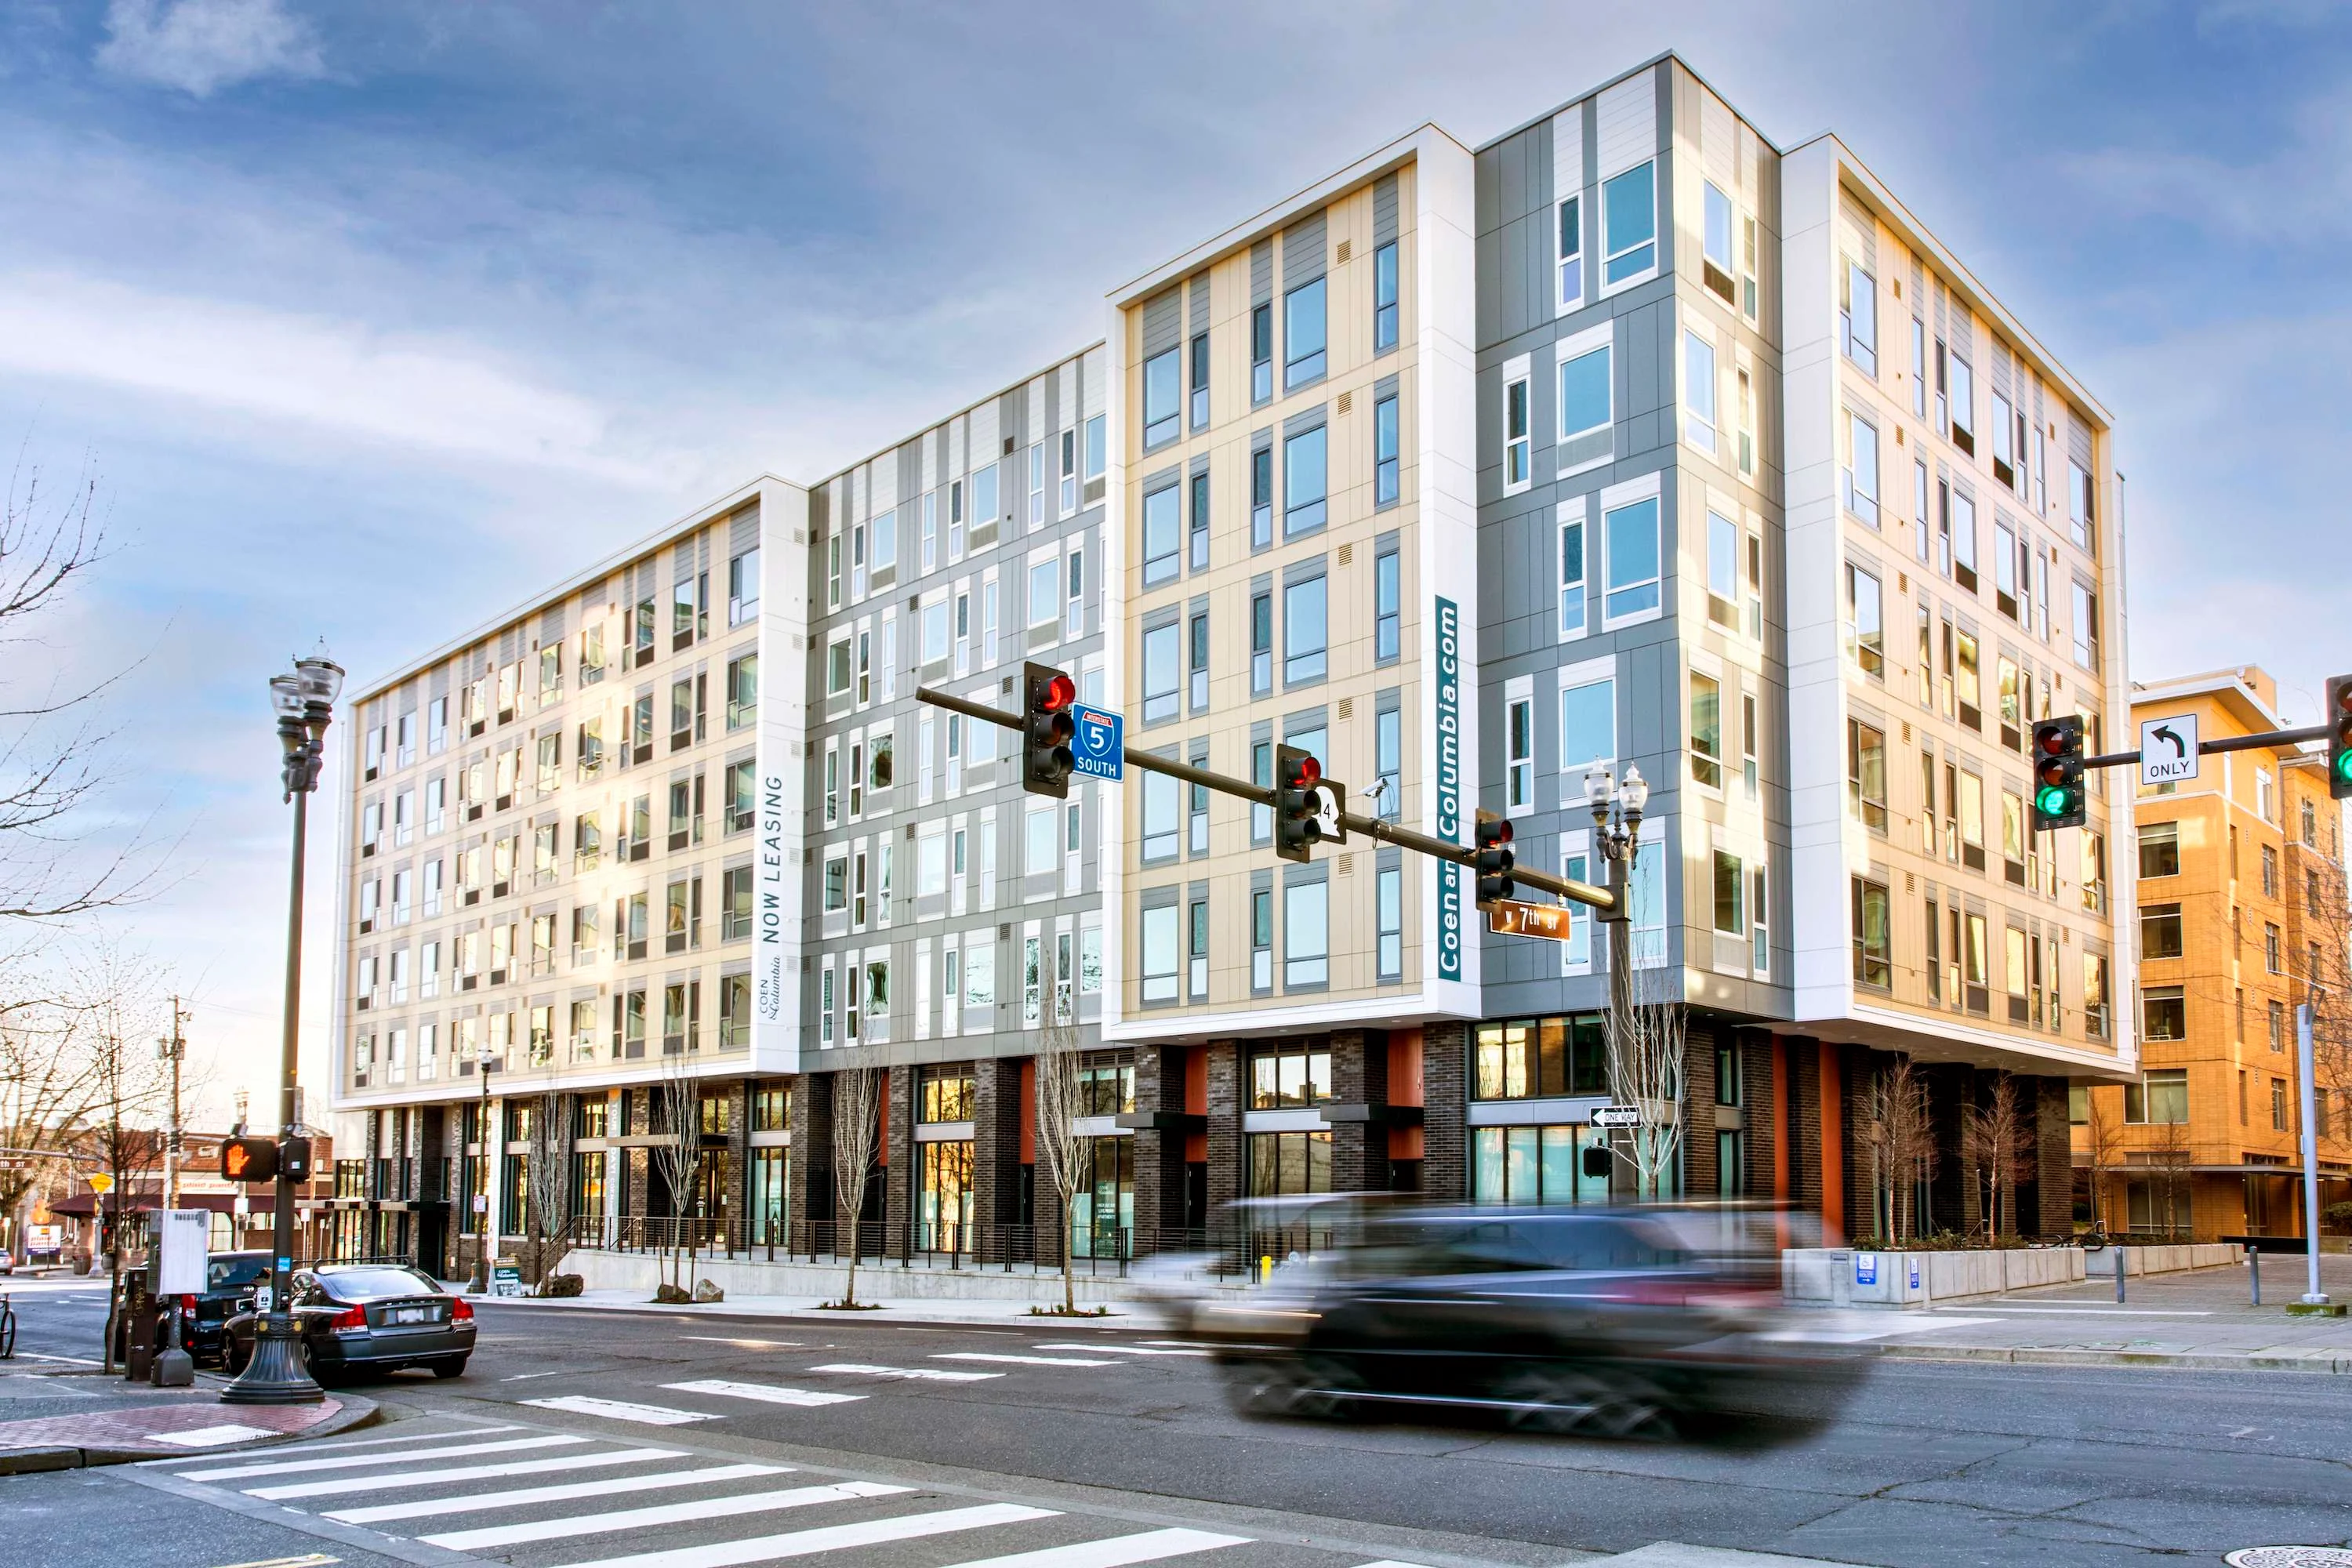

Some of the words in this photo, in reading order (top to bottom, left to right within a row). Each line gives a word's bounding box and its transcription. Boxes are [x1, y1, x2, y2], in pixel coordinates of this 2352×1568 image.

[1086, 714, 1110, 724] INTERSTATE
[1090, 726, 1105, 749] 5
[1077, 757, 1116, 777] SOUTH
[2151, 760, 2189, 777] ONLY
[1439, 606, 1458, 972] CoenanColumbia.com
[764, 776, 782, 882] LEASING
[763, 892, 780, 943] NOW
[1505, 910, 1512, 924] W
[1519, 907, 1540, 931] 7th
[1547, 916, 1560, 930] ST
[760, 979, 768, 1014] COEN
